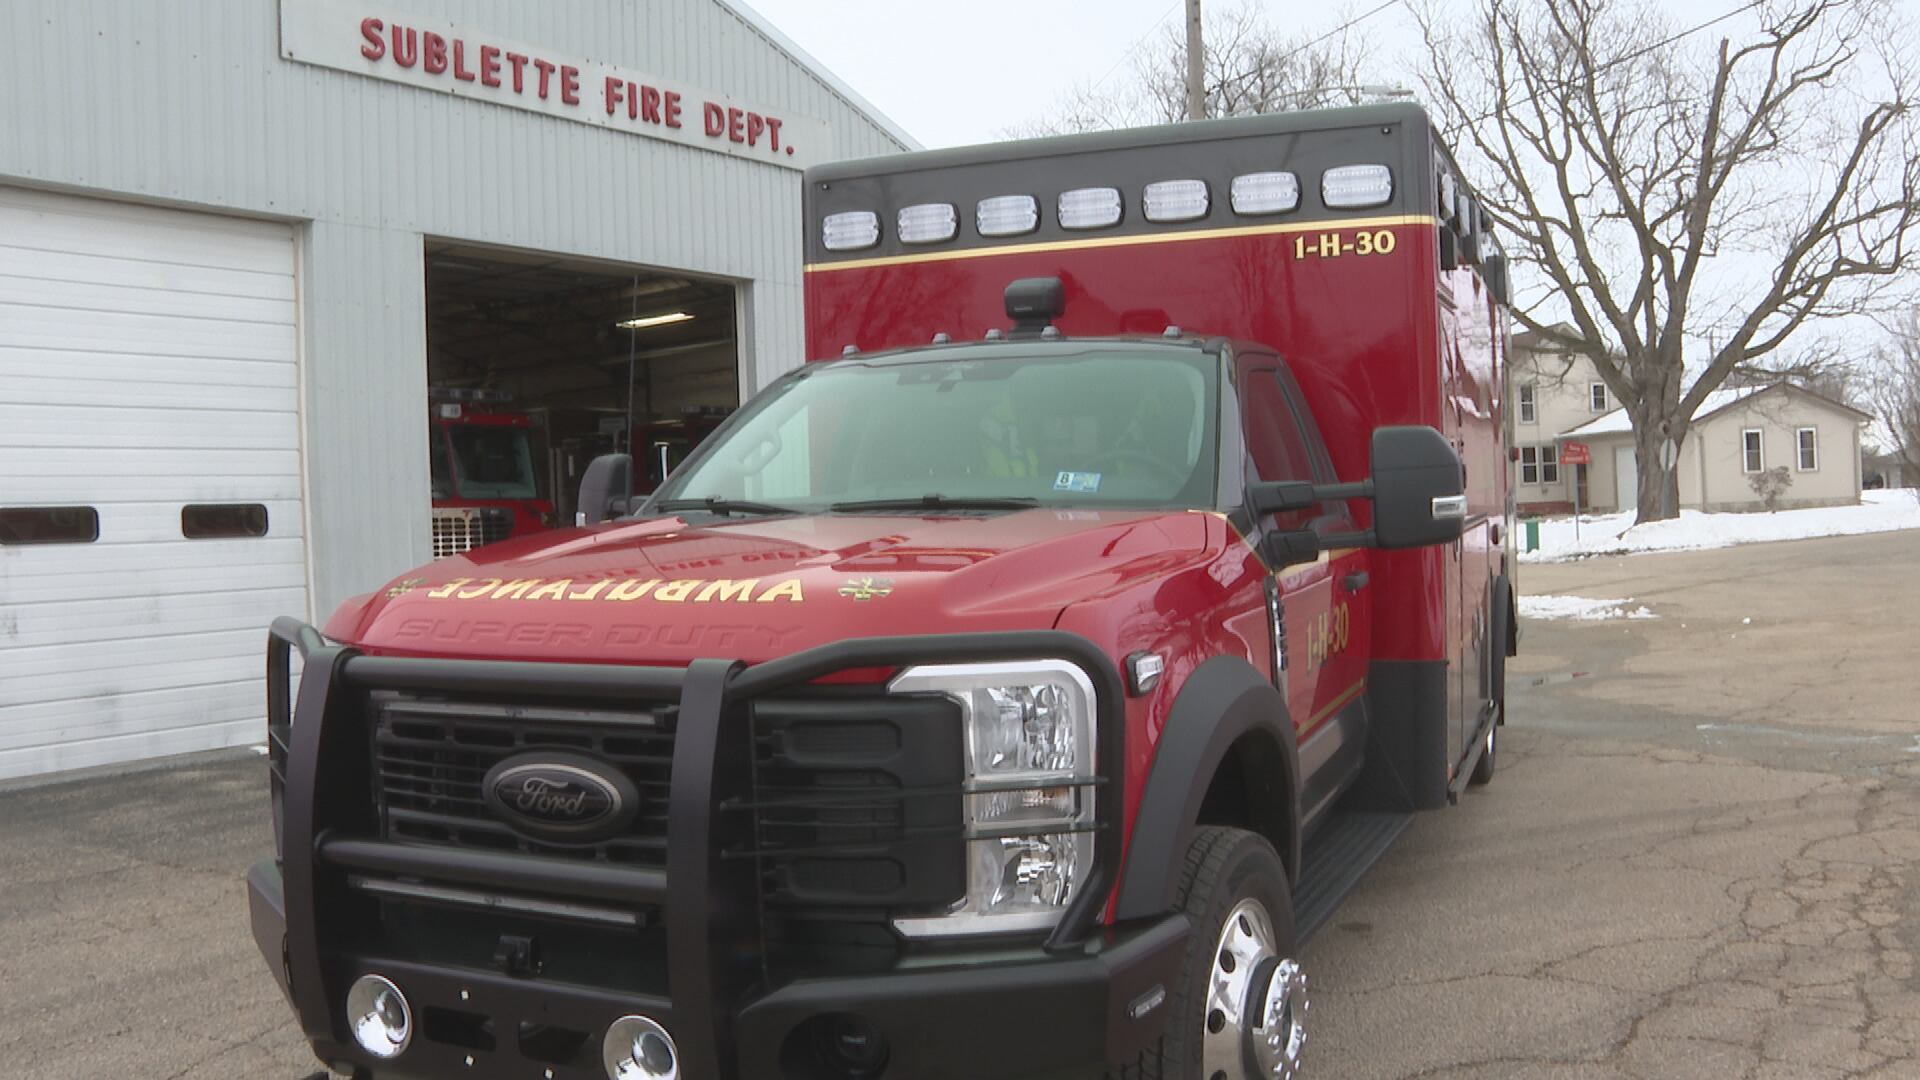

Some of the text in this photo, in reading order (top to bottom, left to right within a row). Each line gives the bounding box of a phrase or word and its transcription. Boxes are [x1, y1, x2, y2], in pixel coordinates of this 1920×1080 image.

[360, 17, 796, 156] SUBLETTE FIRE DEPT.
[1294, 230, 1396, 260] 1-H-30
[395, 618, 804, 648] SUPER DUTY
[1306, 602, 1349, 671] 1-H-30
[516, 777, 587, 816] Ford
